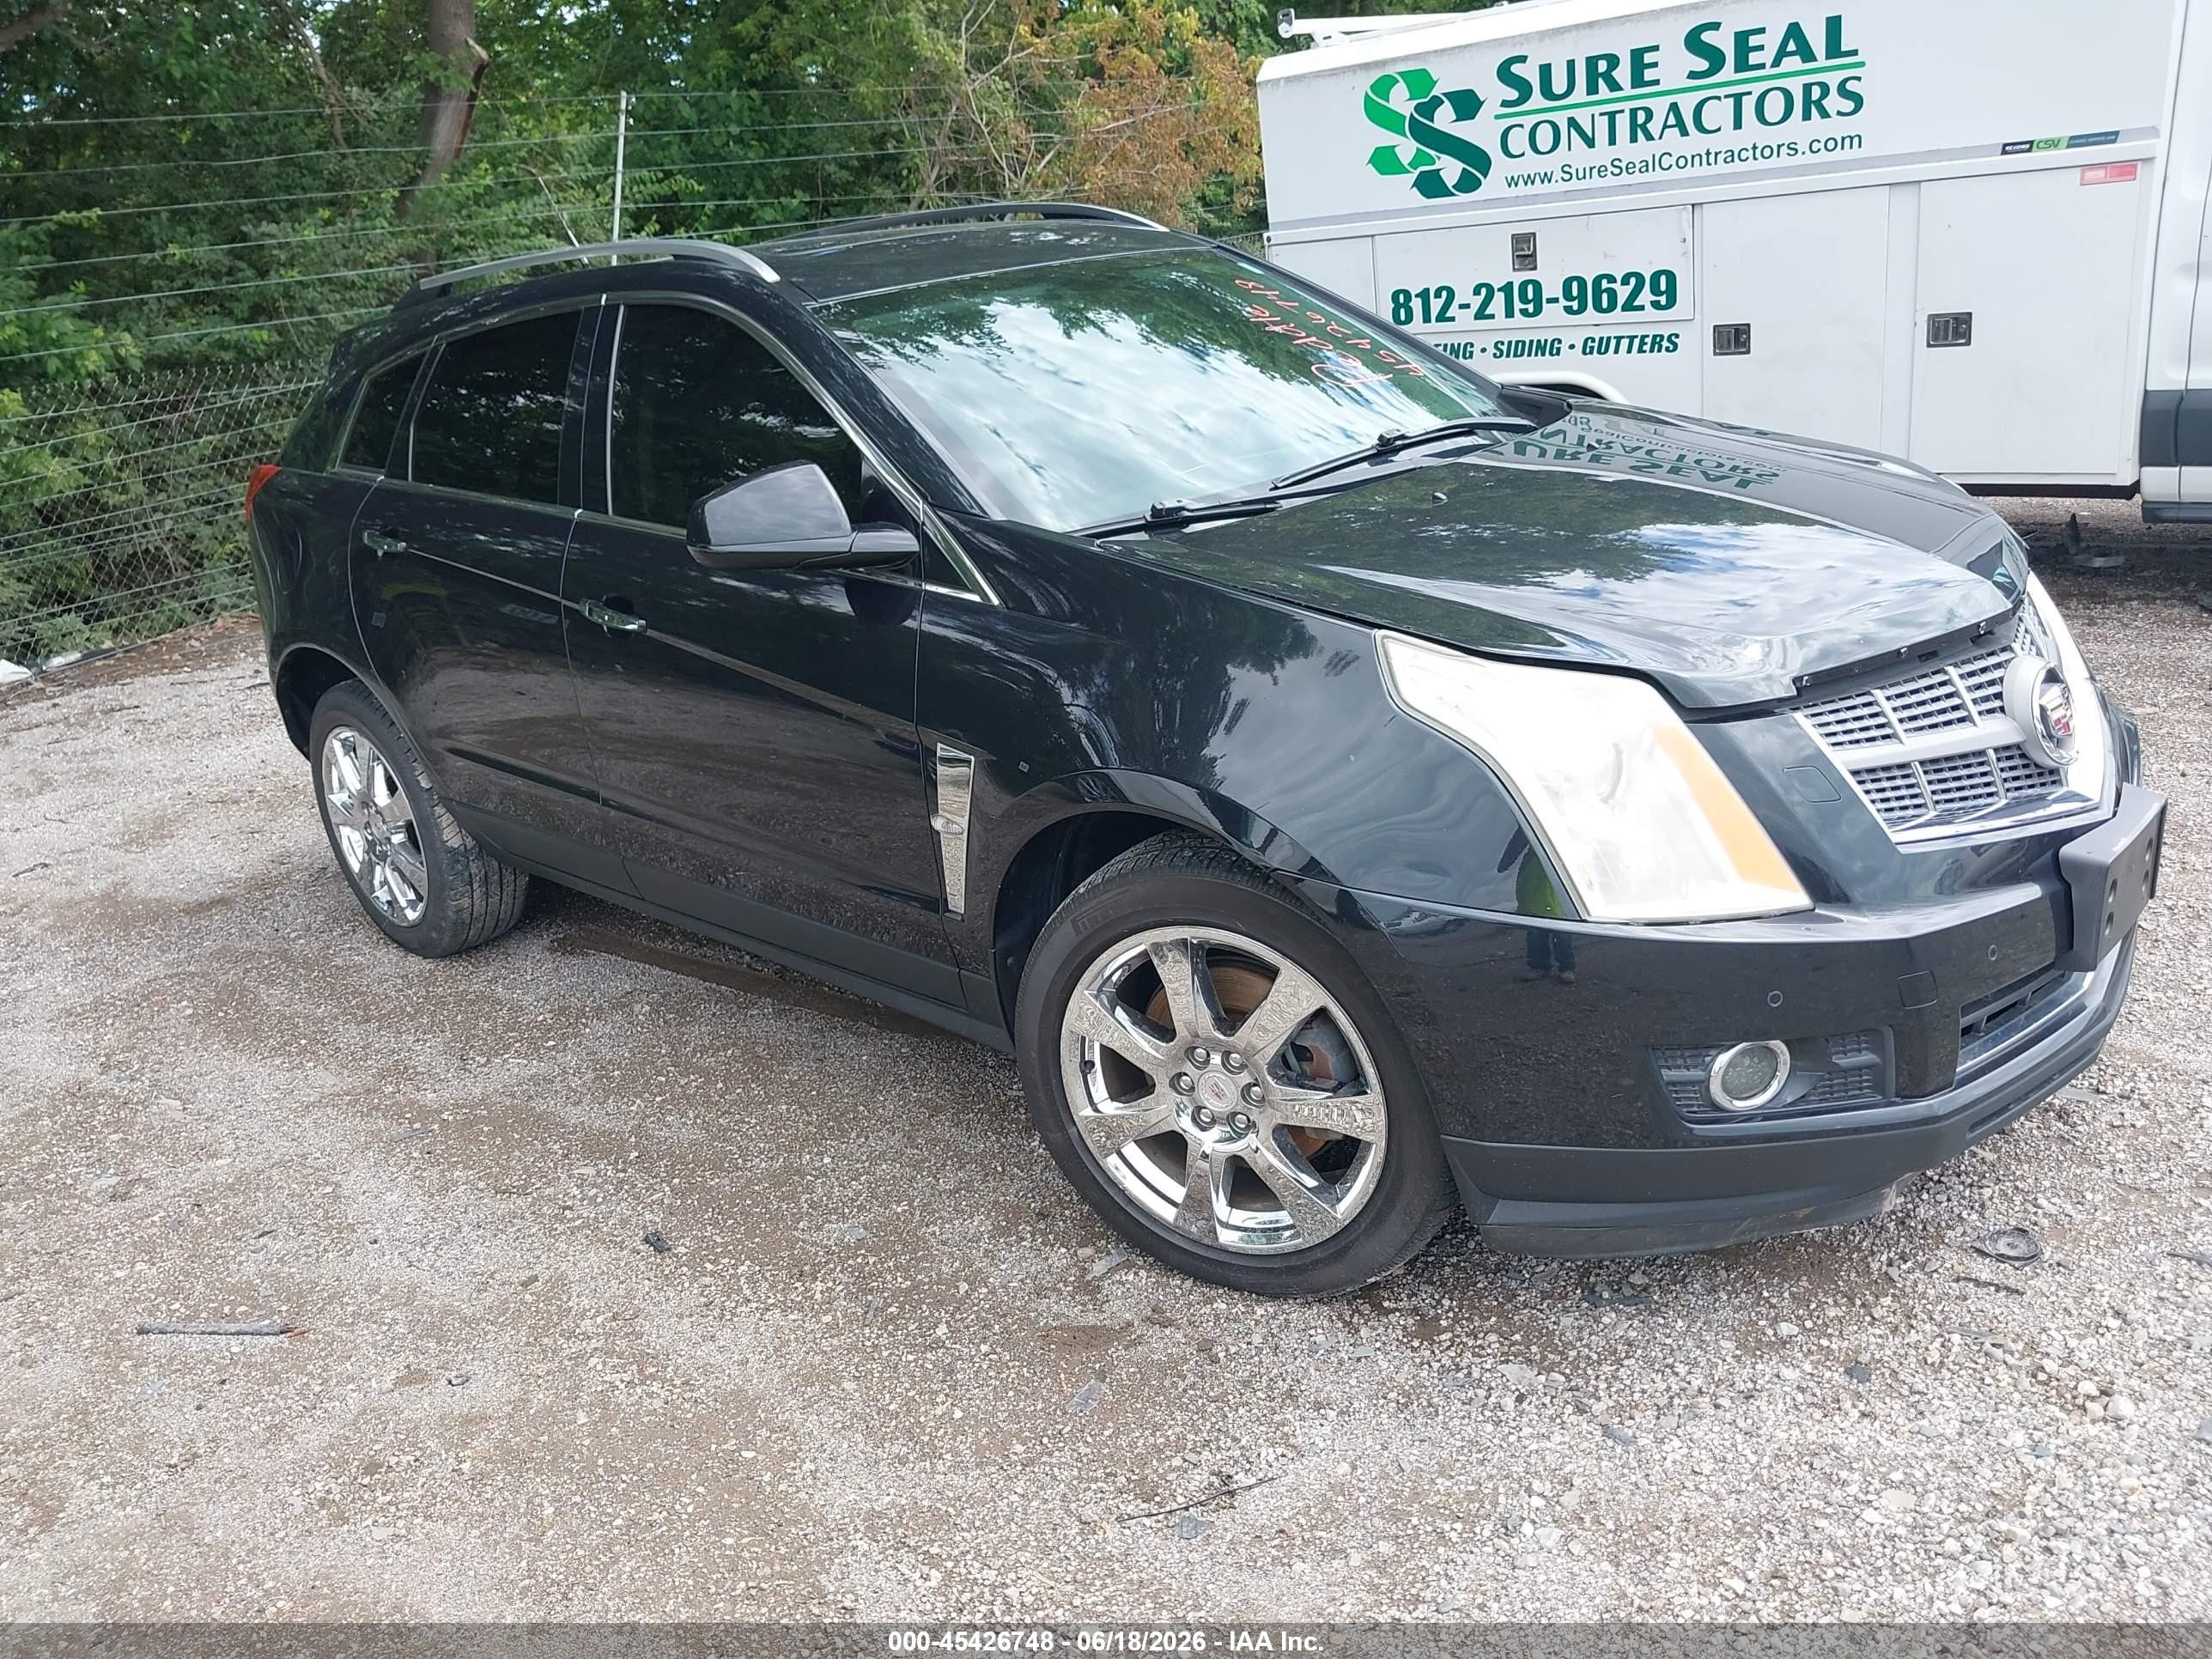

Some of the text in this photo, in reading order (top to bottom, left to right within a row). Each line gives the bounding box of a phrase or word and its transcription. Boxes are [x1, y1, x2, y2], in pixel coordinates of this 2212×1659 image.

[1496, 15, 1859, 109] SURE SEAL
[1500, 76, 1864, 160] CONTRACTORS
[2036, 137, 2061, 150] CSV
[1505, 133, 1863, 188] www.SureSealContractors.com
[1391, 269, 1677, 326] 812-219-9629
[1235, 279, 1425, 378] 45426748
[1434, 332, 1680, 362] ING SIDING GUTTERS
